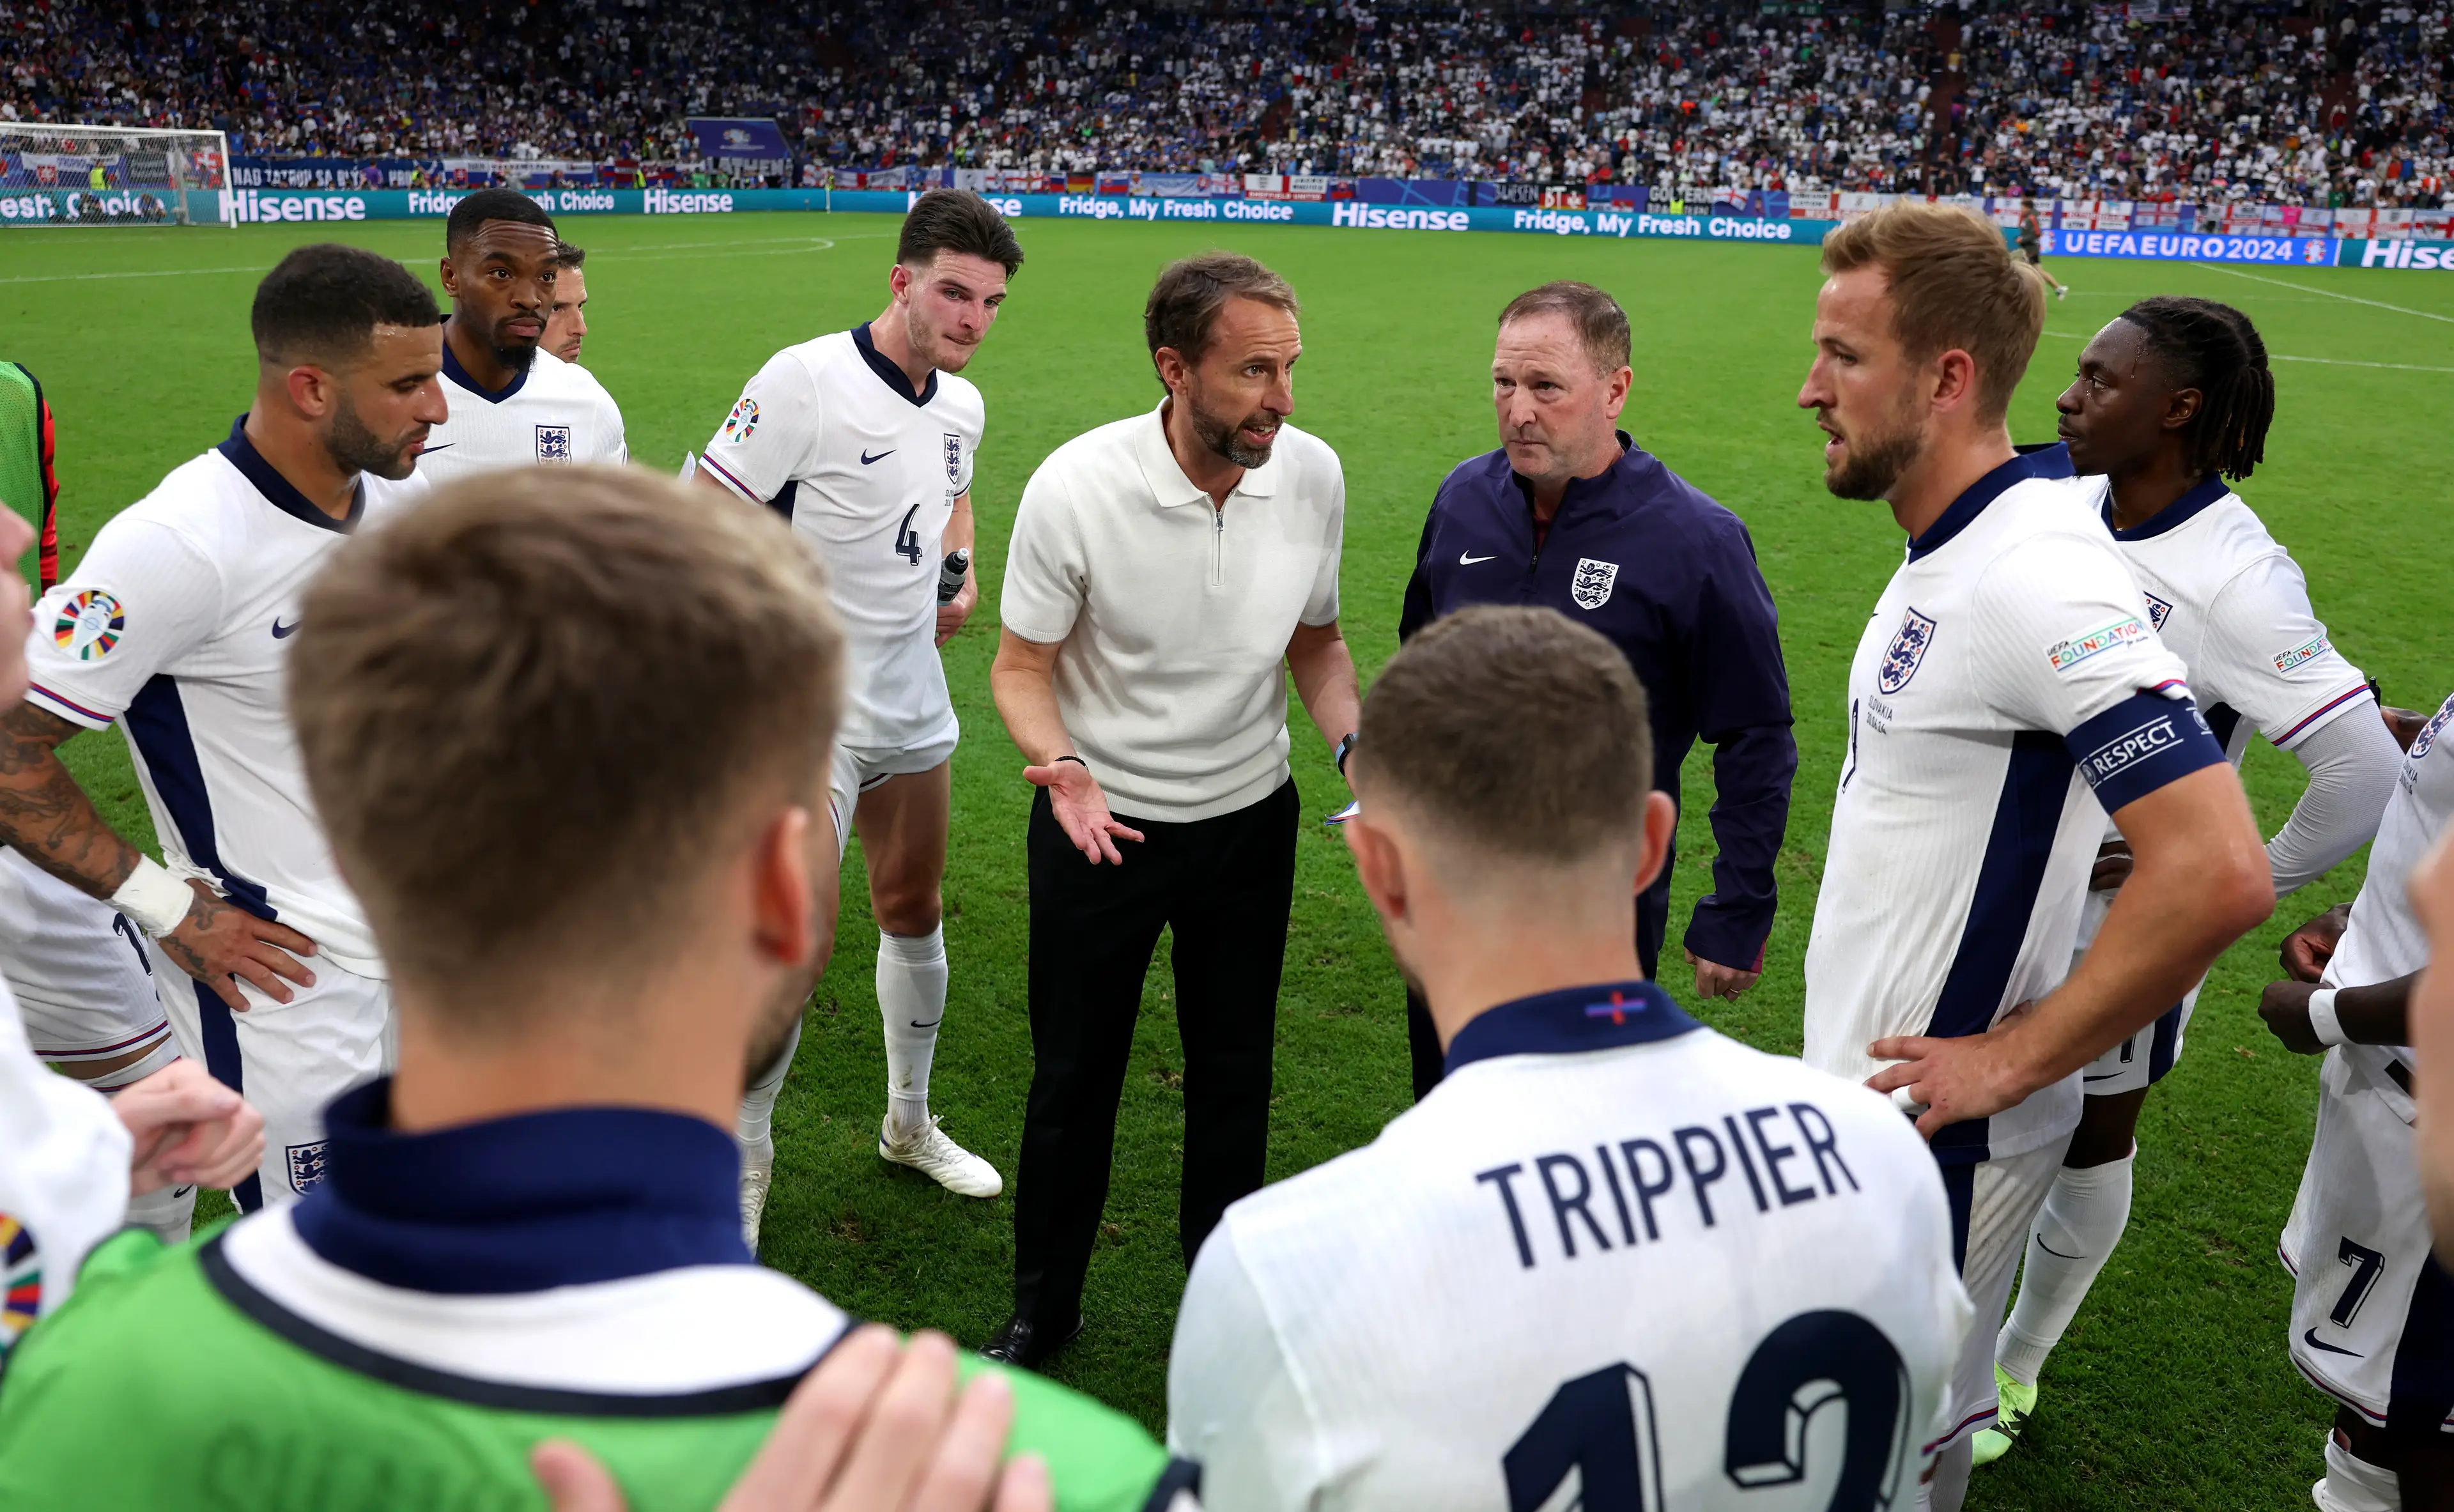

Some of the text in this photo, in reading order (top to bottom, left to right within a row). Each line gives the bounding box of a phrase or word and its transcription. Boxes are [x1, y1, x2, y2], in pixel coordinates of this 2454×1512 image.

[219, 190, 365, 222] Hisense
[560, 189, 614, 211] Choice
[644, 189, 733, 214] Hisense
[1059, 196, 1293, 220] Fridge, My Fresh Choice
[1332, 202, 1469, 231] Hisense
[1514, 208, 1791, 239] Fridge, My Fresh Choice
[895, 504, 923, 566] 4
[2047, 640, 2071, 657] UEFA
[2273, 651, 2292, 662] UEFA
[1868, 695, 1893, 721] SLOVAKIA
[2092, 720, 2176, 775] RESPECT
[1476, 1102, 1861, 1270] TRIPPIER
[2330, 1236, 2385, 1329] 7
